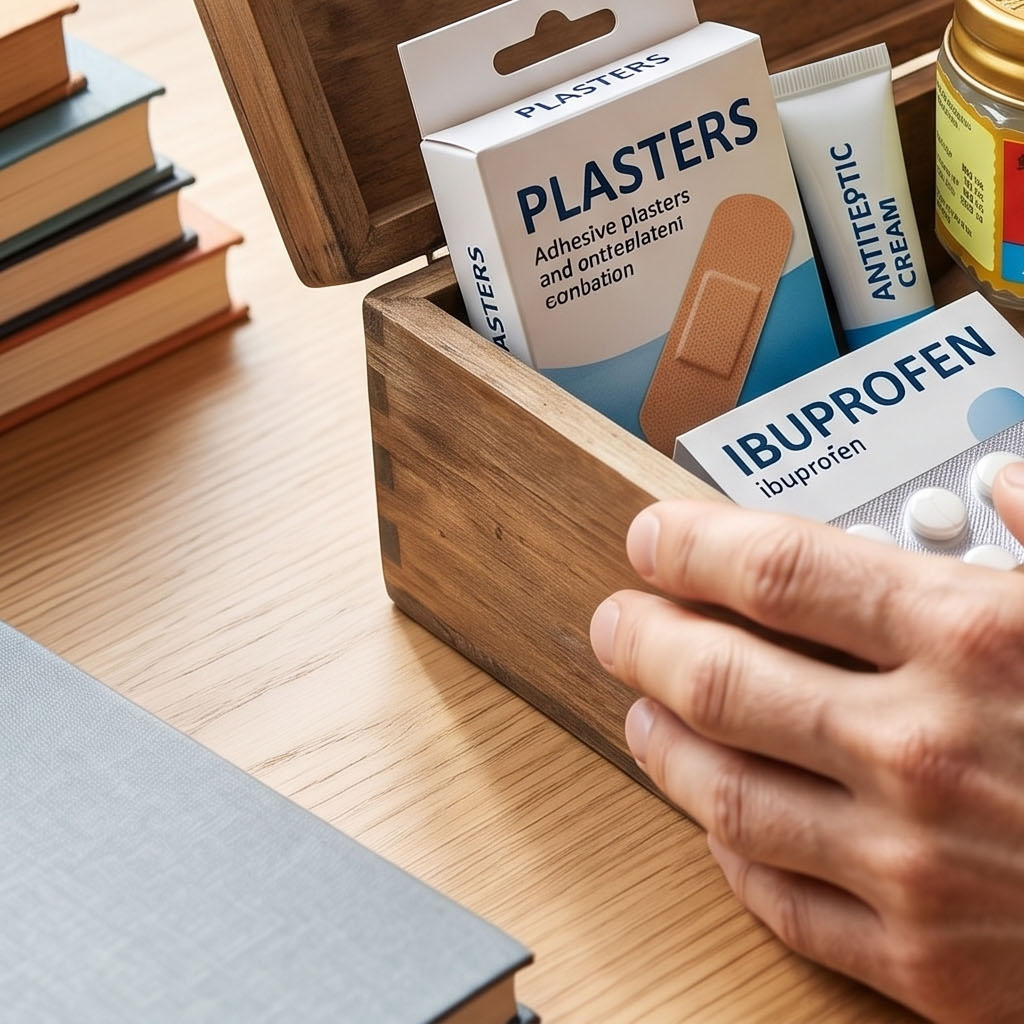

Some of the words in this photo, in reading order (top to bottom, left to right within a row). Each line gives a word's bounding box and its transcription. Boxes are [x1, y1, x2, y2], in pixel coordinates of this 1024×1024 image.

[515, 54, 671, 118] PLASTERS
[517, 97, 758, 234] PLASTERS
[535, 221, 616, 266] Adhesive
[621, 190, 690, 233] plasters
[879, 197, 917, 287] CREAM
[467, 246, 510, 352] ASTERS
[540, 259, 573, 288] and
[721, 326, 996, 476] IBUPROFEN
